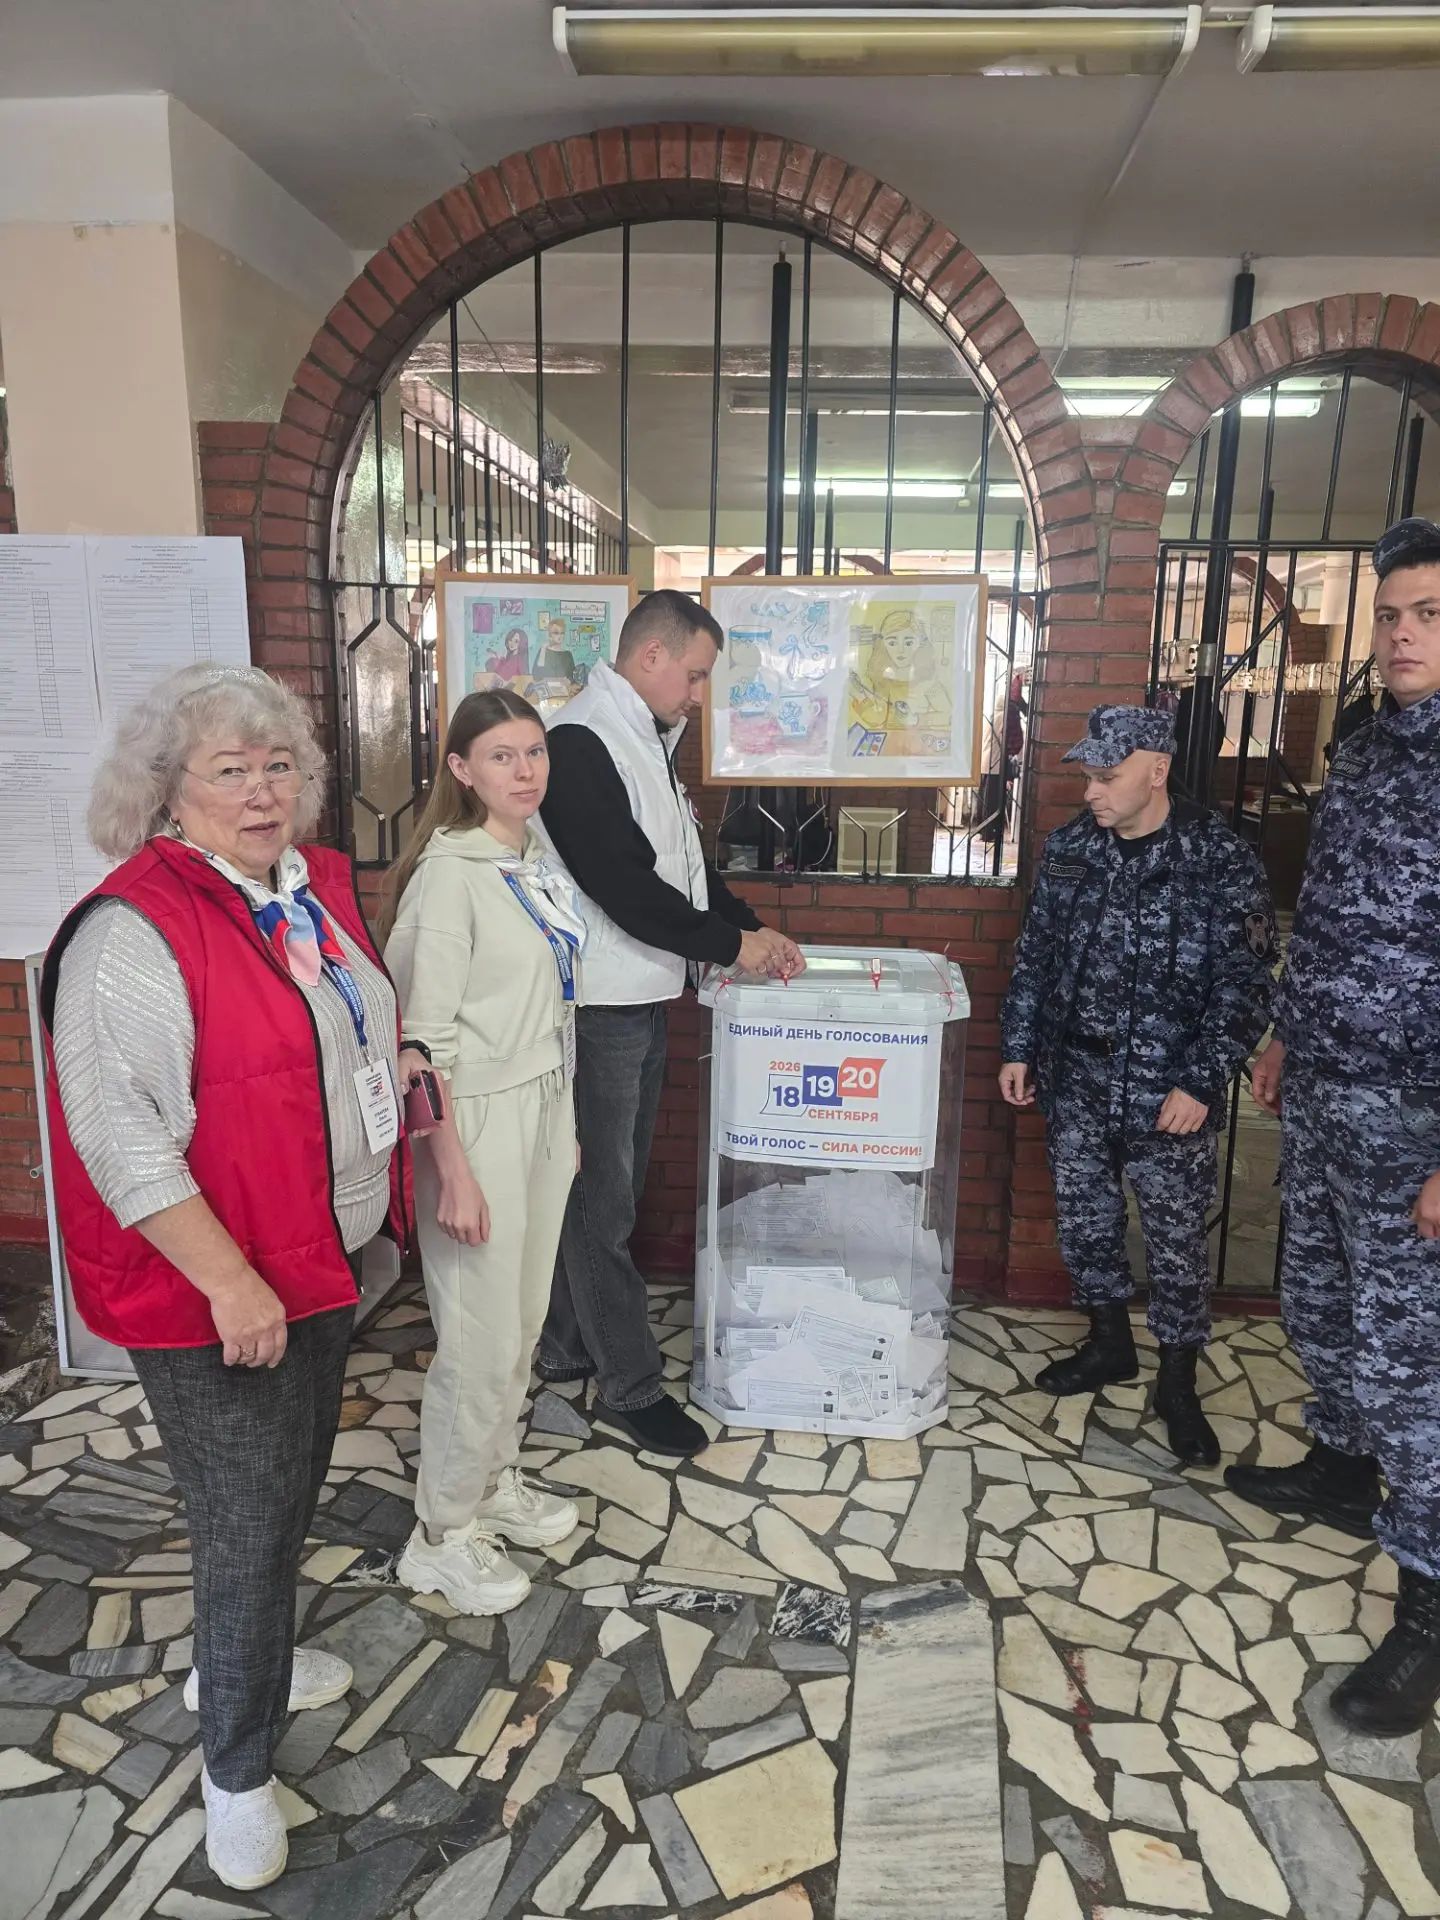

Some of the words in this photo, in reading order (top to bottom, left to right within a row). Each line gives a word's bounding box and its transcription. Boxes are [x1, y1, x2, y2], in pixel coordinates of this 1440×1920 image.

[729, 1023, 783, 1037] ЕДИНЫЙ
[786, 1028, 823, 1040] ДЕНЬ
[826, 1030, 928, 1045] ГОЛОСОВАНИЯ
[769, 1061, 800, 1072] 2026
[773, 1085, 800, 1108] 18
[806, 1075, 835, 1098] 19
[841, 1066, 877, 1089] 20
[808, 1108, 879, 1122] СЕНТЯБРЯ
[726, 1131, 758, 1147] ТВОЙ
[761, 1137, 806, 1150] ГОЛОС
[822, 1141, 859, 1154] СИЛА
[862, 1144, 922, 1156] РОССИИ!
